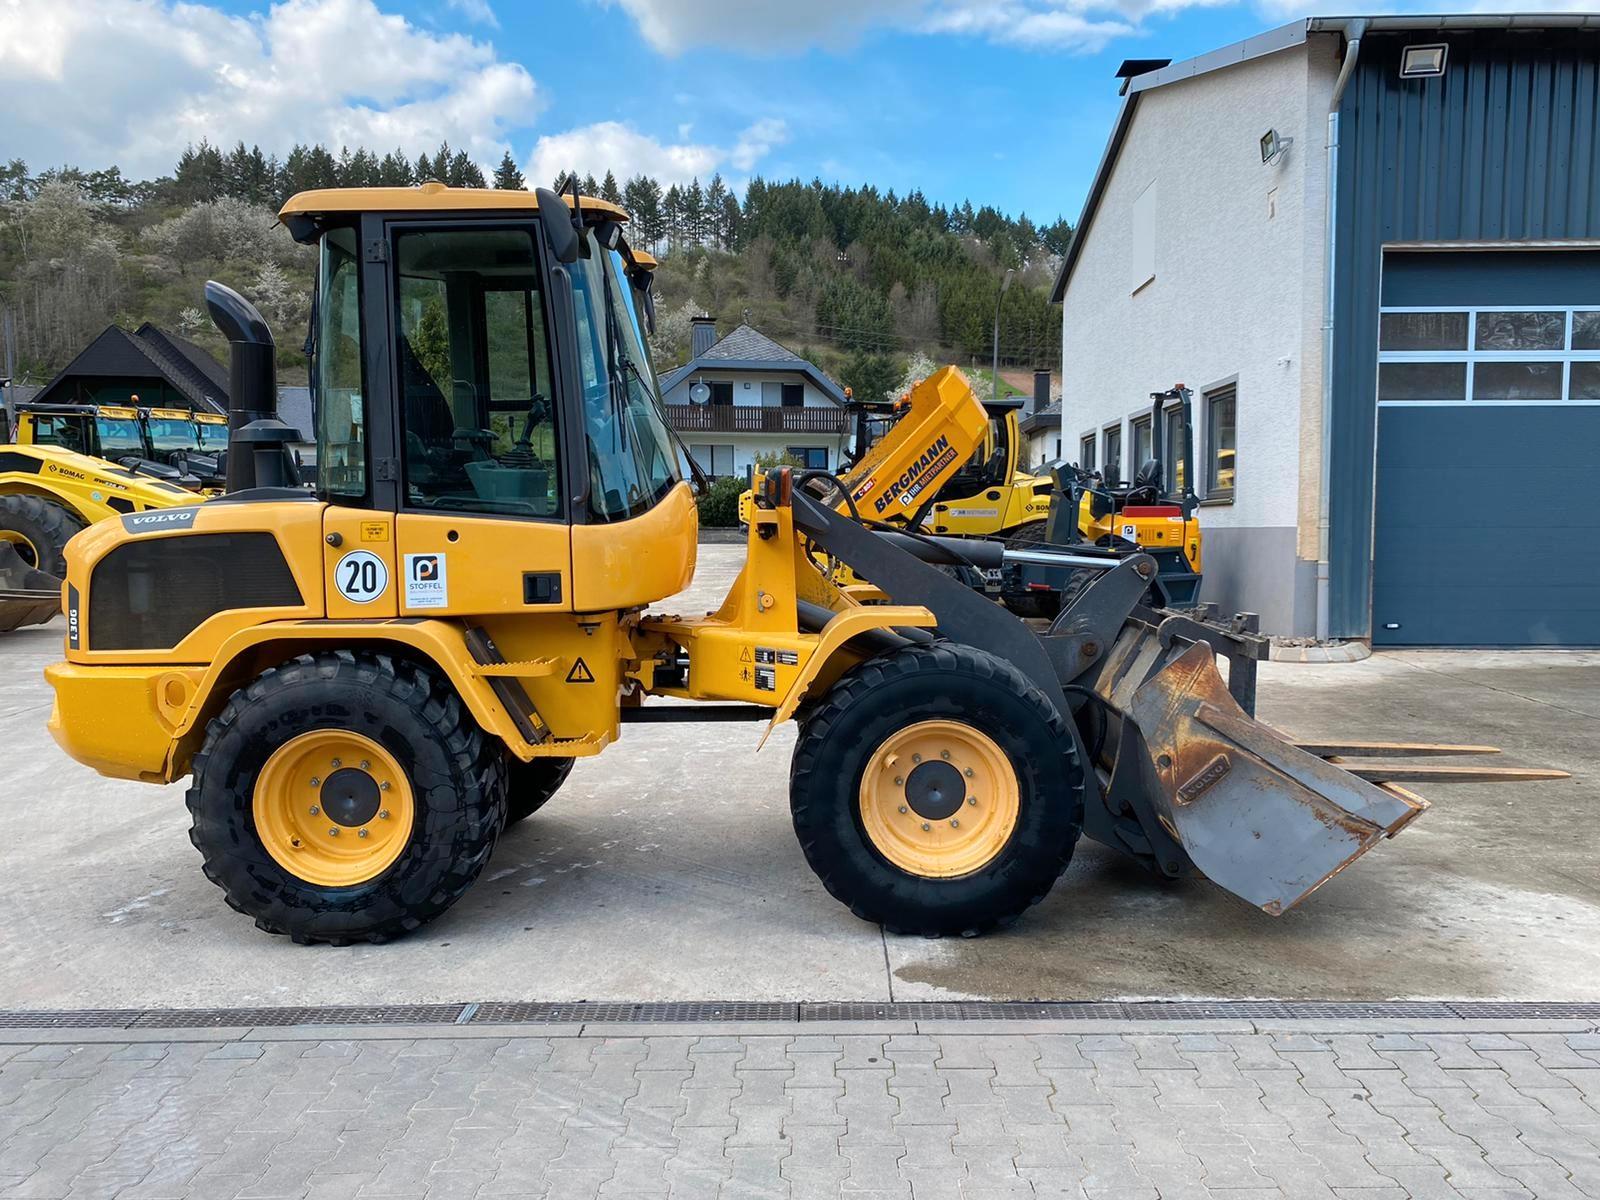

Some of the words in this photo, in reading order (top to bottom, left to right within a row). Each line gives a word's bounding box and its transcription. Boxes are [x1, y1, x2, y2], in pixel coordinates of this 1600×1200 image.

[59, 467, 85, 480] BOMAG
[873, 434, 949, 514] BERGMANN
[908, 483, 922, 497] IHR
[132, 512, 191, 525] VOLVO
[345, 560, 377, 594] 20
[409, 582, 443, 590] STOFFEL
[1187, 762, 1224, 794] VOLVO
